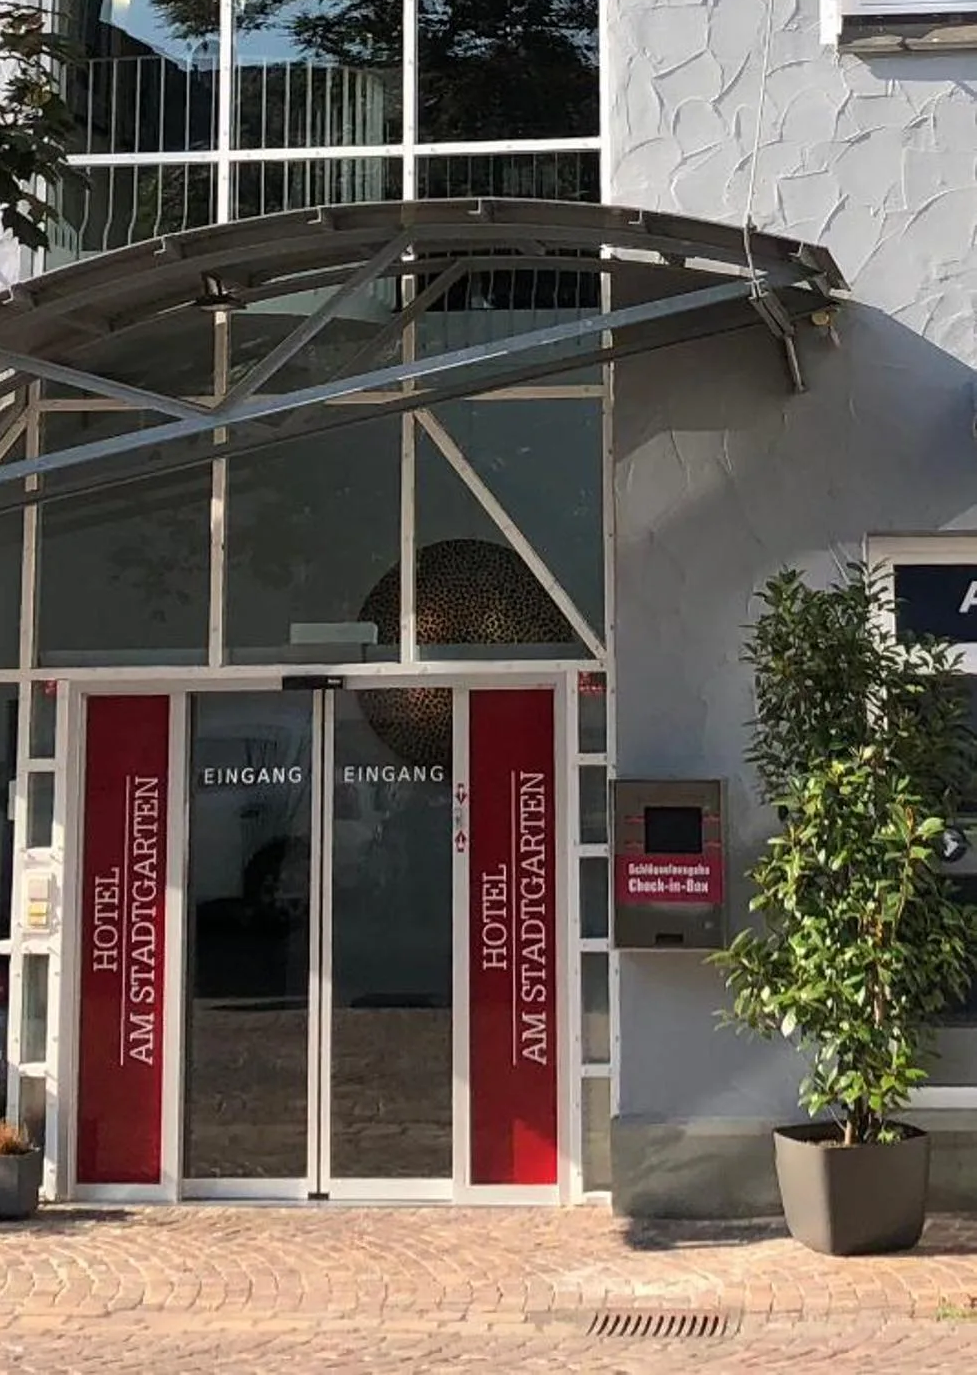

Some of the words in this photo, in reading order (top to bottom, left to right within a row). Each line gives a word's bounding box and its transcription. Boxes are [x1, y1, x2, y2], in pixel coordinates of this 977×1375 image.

[203, 766, 303, 785] EINGANG
[343, 765, 444, 783] EINGANG
[129, 776, 160, 1005] STADTGARTEN
[520, 771, 547, 1003] STADTGARTEN
[627, 877, 709, 894] Check-in-Box
[93, 867, 121, 973] HOTEL
[482, 863, 508, 971] HOTEL
[129, 1012, 154, 1066] AM
[522, 1011, 547, 1066] AM
